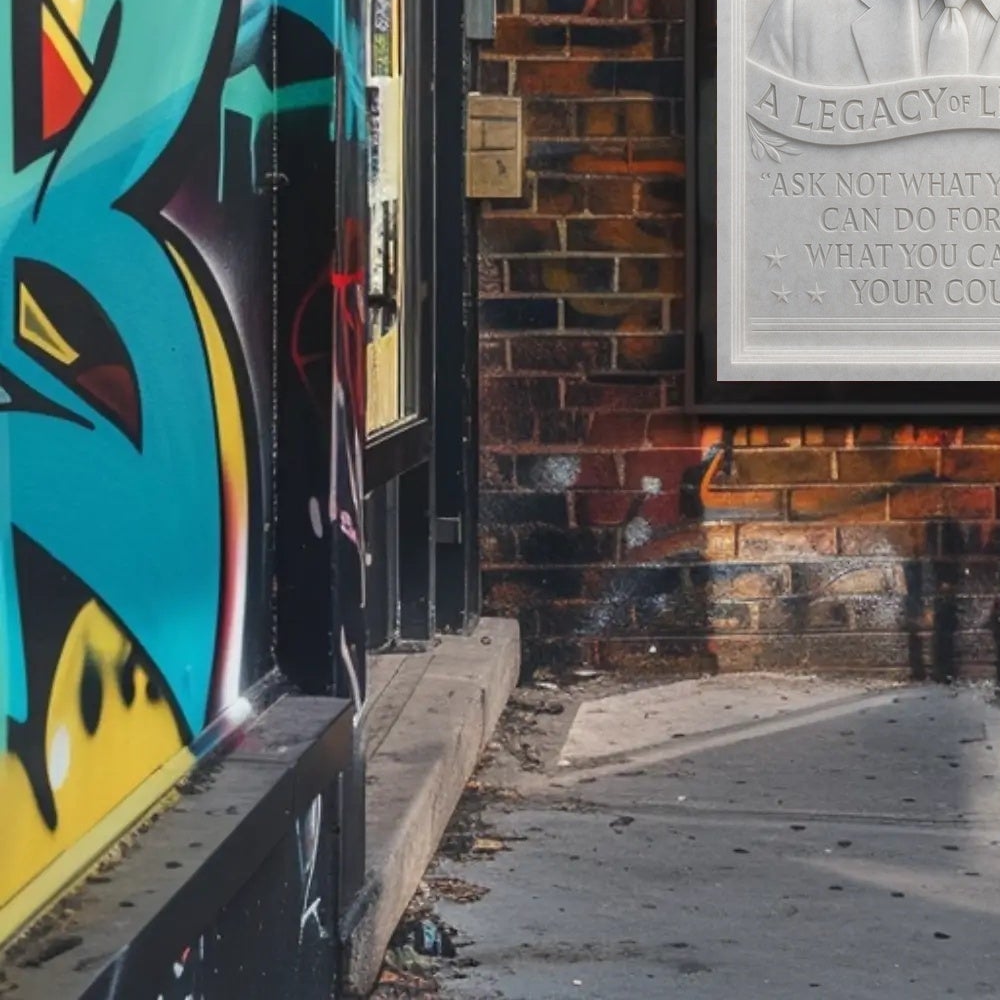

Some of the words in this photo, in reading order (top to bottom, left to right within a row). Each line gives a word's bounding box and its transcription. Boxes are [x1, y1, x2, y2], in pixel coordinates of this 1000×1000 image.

[753, 82, 779, 120] A
[792, 87, 948, 132] LEGACY
[949, 95, 971, 113] OF
[760, 172, 826, 198] “ASK
[834, 172, 892, 198] NOT
[899, 172, 982, 198] WHAT
[819, 207, 881, 233] CAN
[894, 207, 936, 233] DO
[804, 243, 893, 270] WHAT
[898, 243, 957, 270] YOU
[850, 278, 934, 306] YOUR
